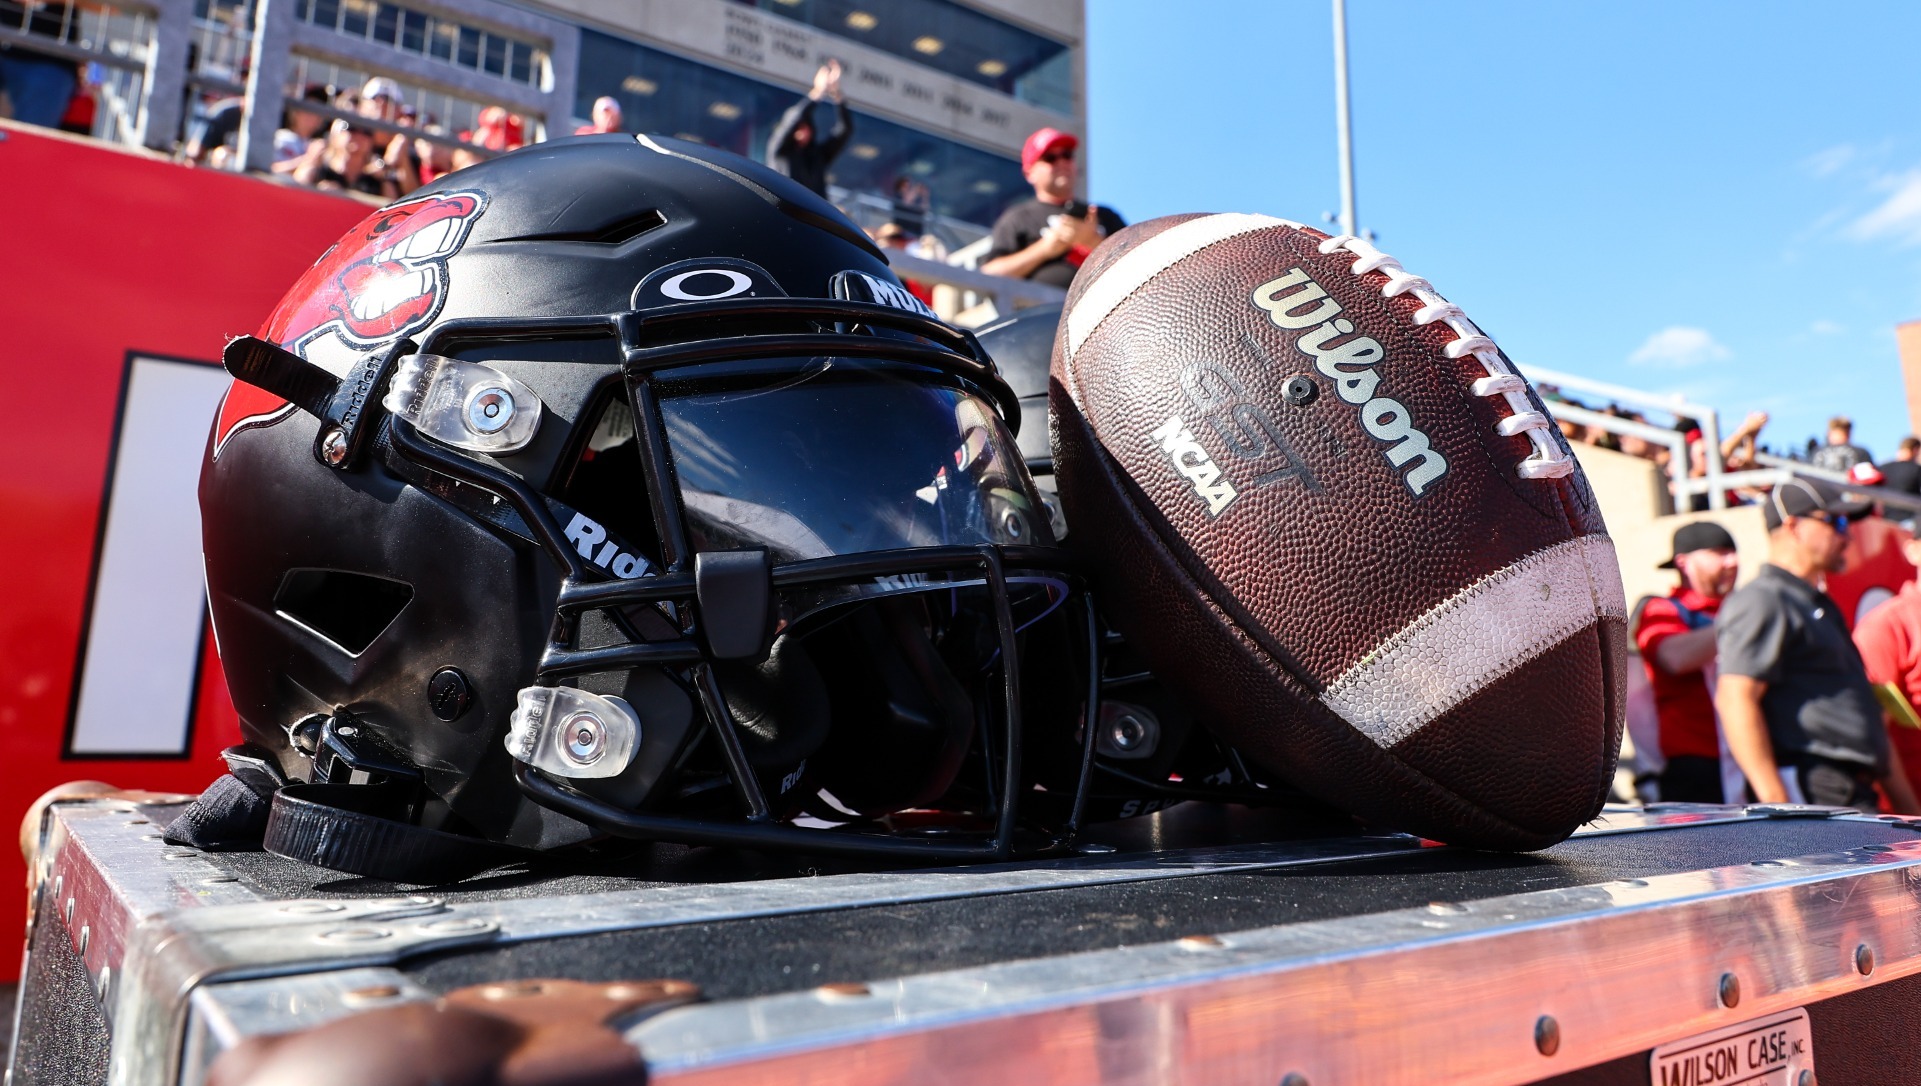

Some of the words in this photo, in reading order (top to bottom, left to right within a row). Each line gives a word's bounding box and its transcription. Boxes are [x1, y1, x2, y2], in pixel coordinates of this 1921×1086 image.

[341, 356, 382, 426] Riddell
[1250, 267, 1449, 498] Wilson
[1150, 416, 1240, 519] NCAA
[1660, 1045, 1738, 1086] WILSON
